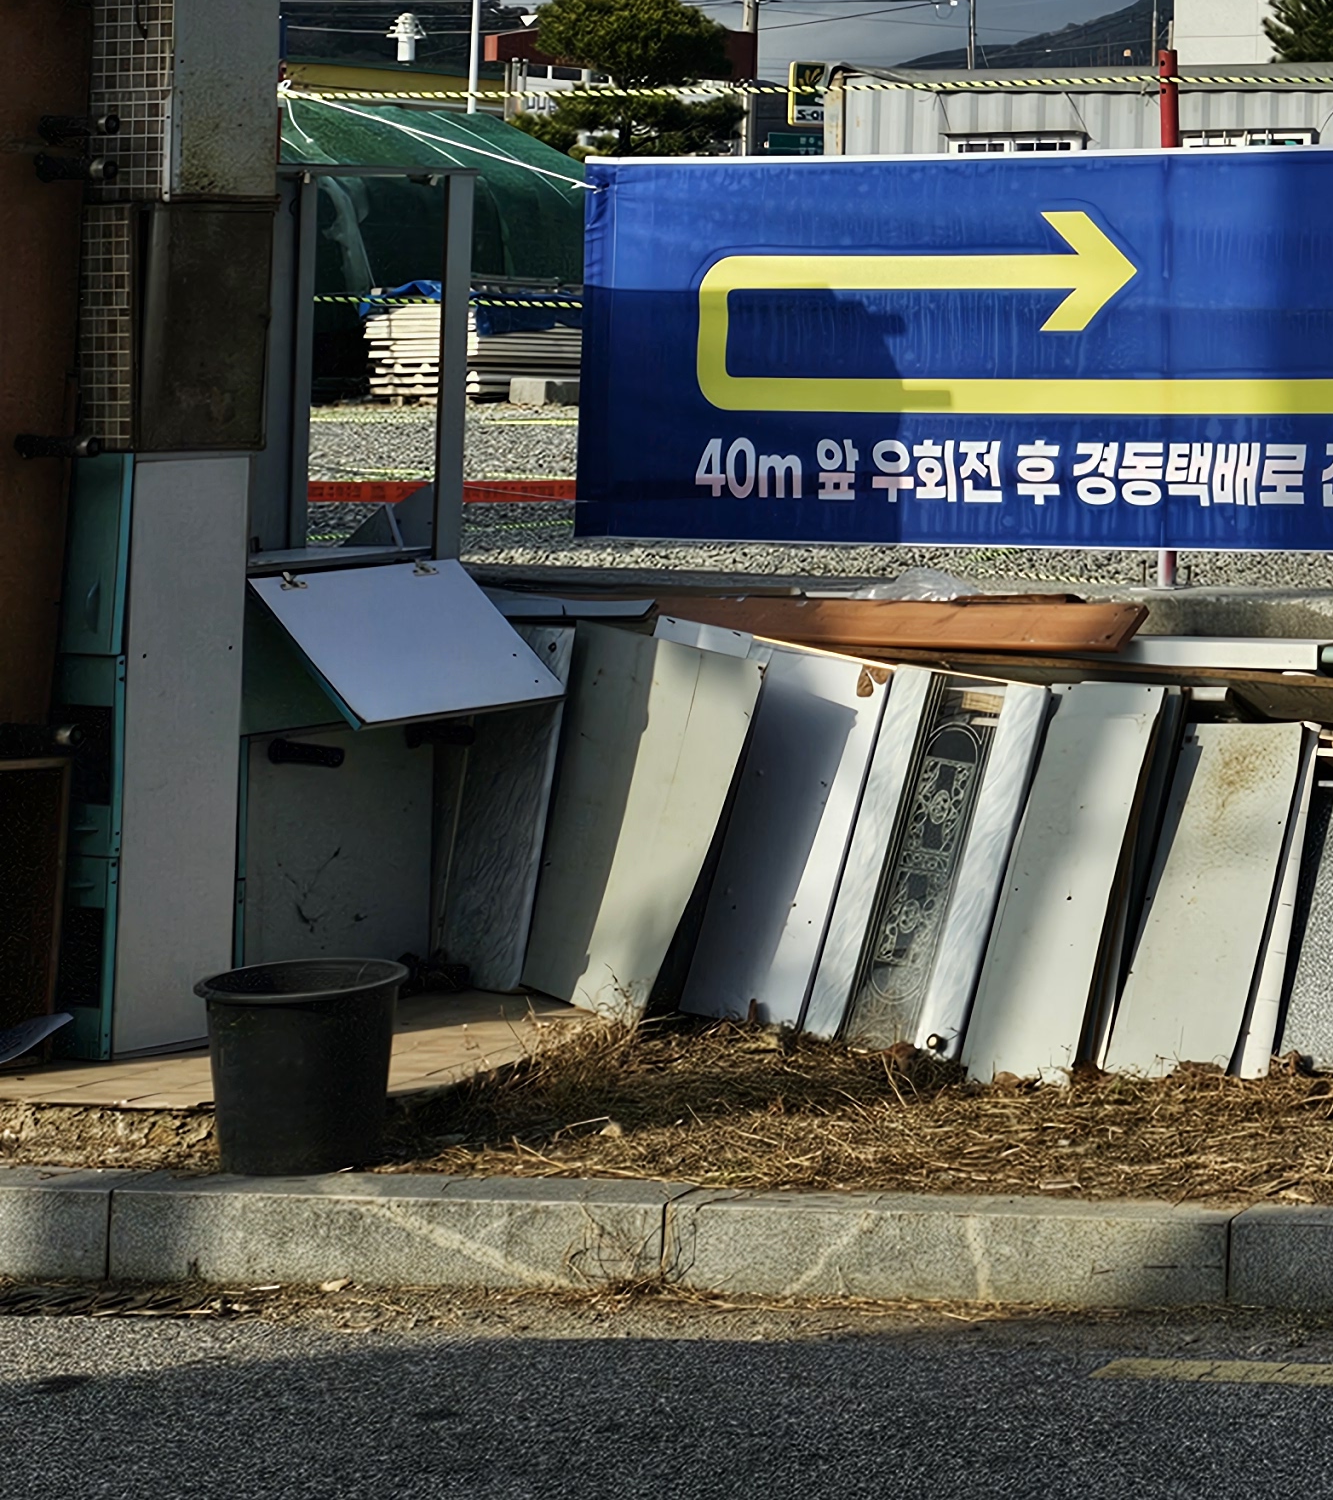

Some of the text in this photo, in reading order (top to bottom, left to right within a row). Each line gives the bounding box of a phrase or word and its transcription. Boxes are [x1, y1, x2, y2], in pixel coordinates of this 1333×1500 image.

[796, 109, 824, 121] S-OI
[696, 438, 802, 500] 40m
[816, 438, 859, 502] 앞
[872, 438, 1002, 504] 우회전
[1016, 440, 1060, 506] 후
[1072, 441, 1308, 508] 경동택배로
